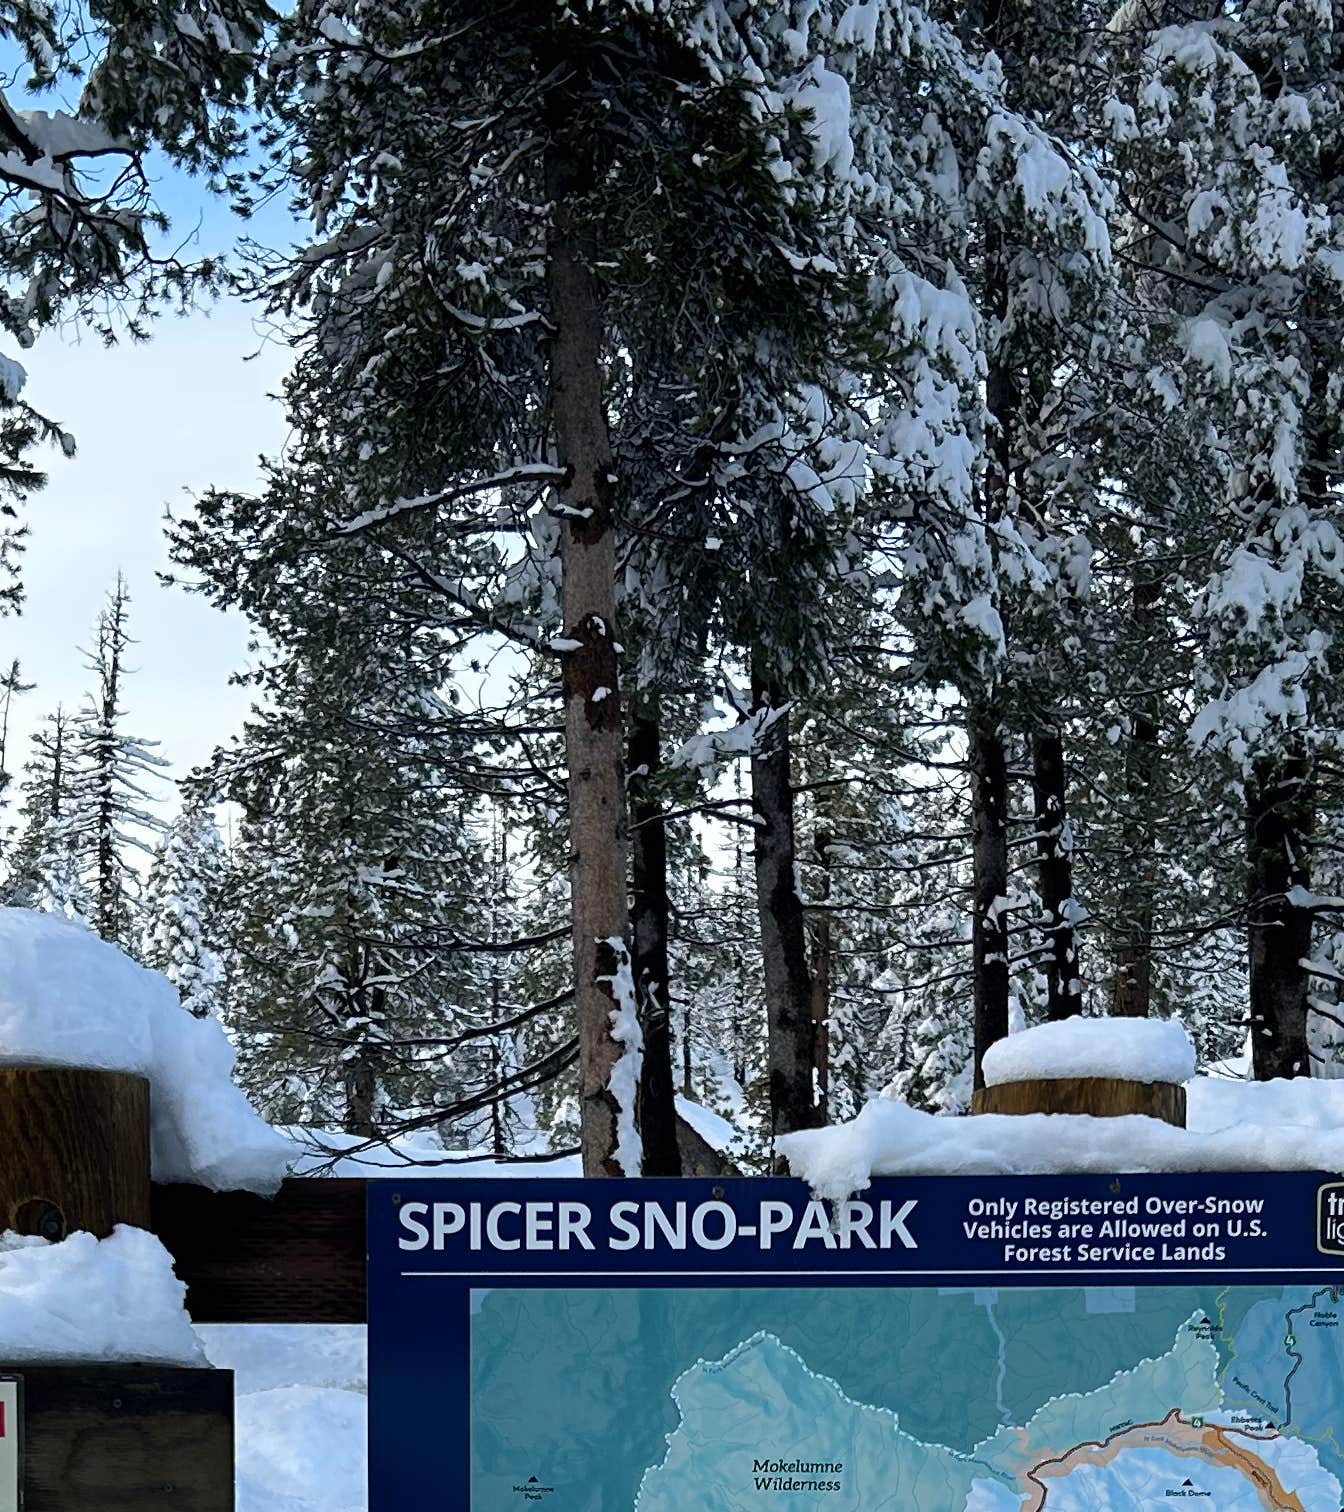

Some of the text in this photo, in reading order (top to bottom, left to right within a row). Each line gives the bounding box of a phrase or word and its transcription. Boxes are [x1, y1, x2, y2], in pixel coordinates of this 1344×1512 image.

[968, 1196, 1264, 1218] Only Registered Over-Snow
[398, 1200, 918, 1250] SPICER SNO-PARK
[963, 1220, 1267, 1239] Vehicles are Allowed on U.S.
[1004, 1242, 1226, 1262] Forest Service Lands
[752, 1459, 842, 1473] Mokelumne
[754, 1477, 841, 1492] Wilderness
